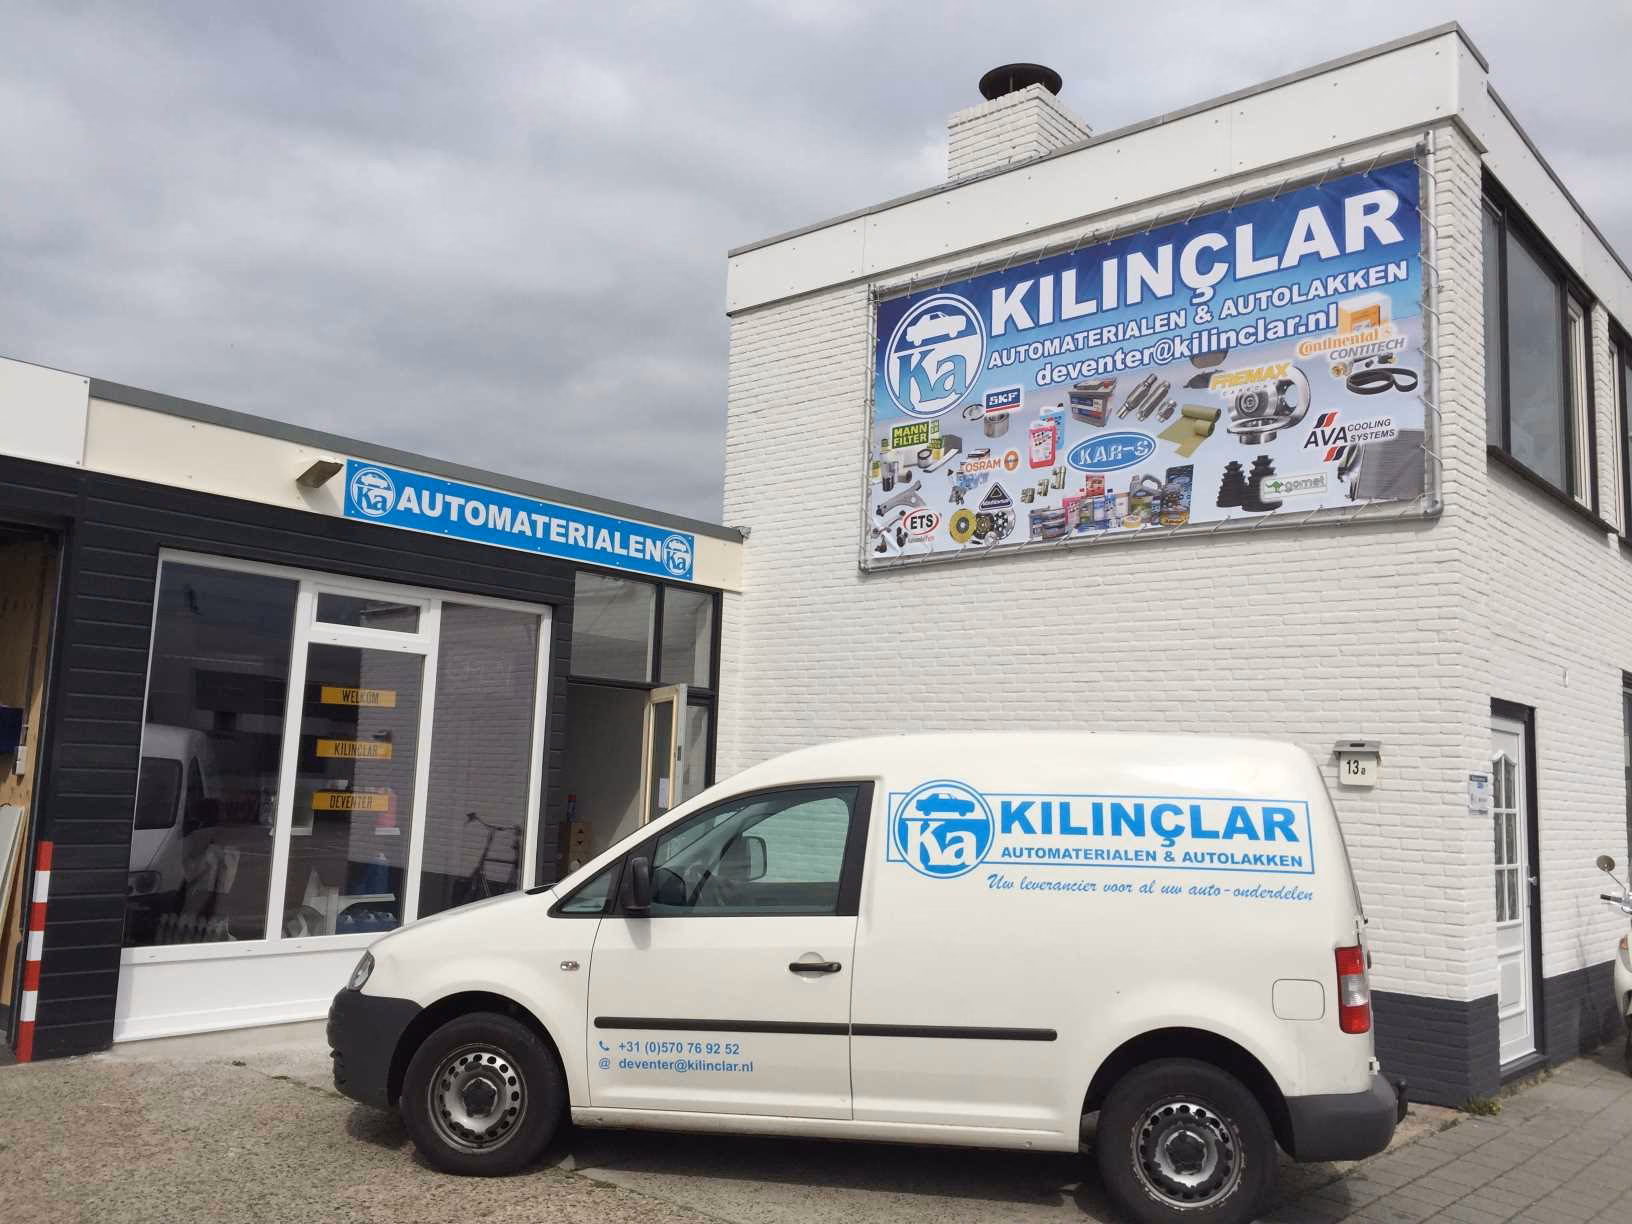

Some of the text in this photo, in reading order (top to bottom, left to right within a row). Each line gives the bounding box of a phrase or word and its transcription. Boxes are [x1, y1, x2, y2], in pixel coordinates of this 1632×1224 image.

[991, 189, 1404, 337] KILINÇLAR
[988, 261, 1408, 369] AUTOMATERIALEN & AUTOLAKKEN
[1036, 302, 1338, 386] deventer@kilinclar.nl
[1329, 337, 1405, 360] CONTITECH
[989, 392, 1017, 405] SKF
[894, 423, 928, 437] MANN
[1347, 418, 1391, 432] COOLING
[894, 433, 928, 446] FILTER
[1304, 426, 1348, 448] AVA
[1350, 429, 1395, 442] SYSTEMS
[965, 458, 1001, 473] OSRAM
[397, 486, 662, 562] AUTOMATERIALEN
[910, 514, 933, 530] ETS
[330, 795, 372, 808] DEVENTER
[1001, 800, 1299, 847] KILINÇLAR
[1001, 847, 1303, 867] AUTOMATERIALEN & AUTOLAKKEN
[987, 874, 1014, 889] Uw
[1020, 877, 1096, 891] leverancier
[1103, 882, 1132, 893] voor
[1139, 880, 1156, 894] al
[1161, 885, 1182, 895] uw
[619, 1041, 740, 1055] +31 (0)570 76 92 52
[619, 1058, 753, 1072] deventer@kilinclar.nl
